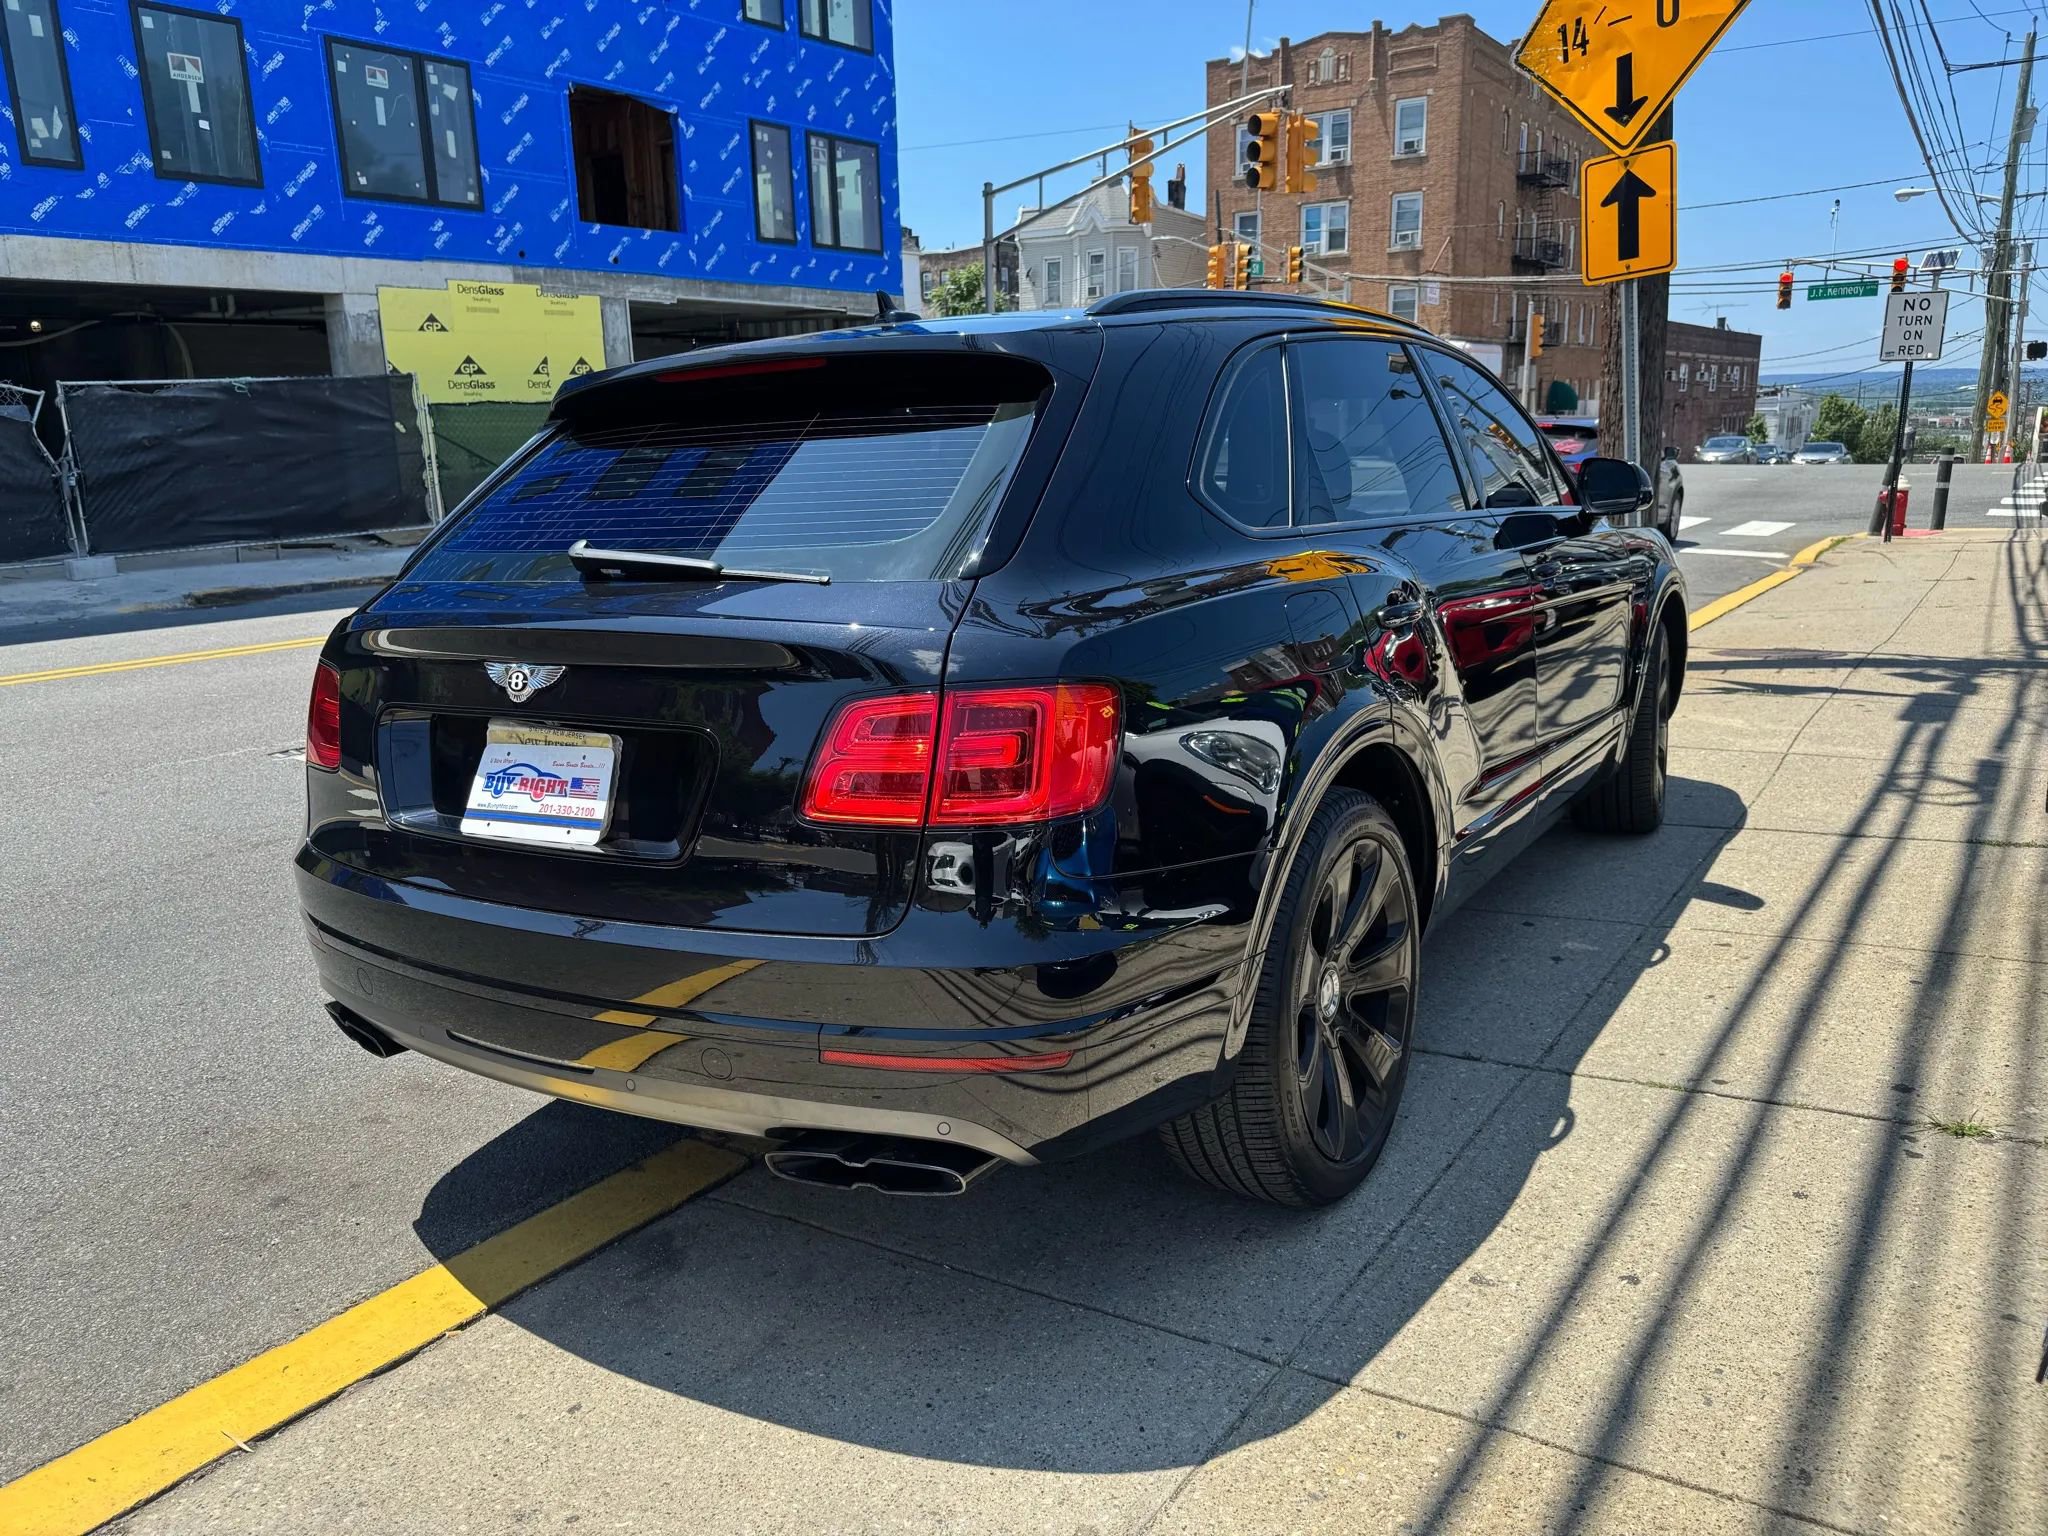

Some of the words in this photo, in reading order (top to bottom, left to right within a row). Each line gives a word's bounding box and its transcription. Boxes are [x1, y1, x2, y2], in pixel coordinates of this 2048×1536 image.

[173, 72, 202, 81] ANDERSEN
[31, 196, 57, 221] Blueskin
[457, 283, 505, 296] DensGlass
[1903, 298, 1931, 311] NO
[1897, 315, 1933, 327] TURN
[423, 322, 441, 332] GP
[1903, 330, 1923, 341] ON
[1898, 345, 1924, 355] RED
[460, 364, 478, 374] GP
[575, 365, 590, 375] GP
[448, 379, 496, 390] DensGlass
[552, 729, 566, 737] NEW
[566, 731, 586, 740] JERSEY
[539, 804, 596, 817] 201-330-2100
